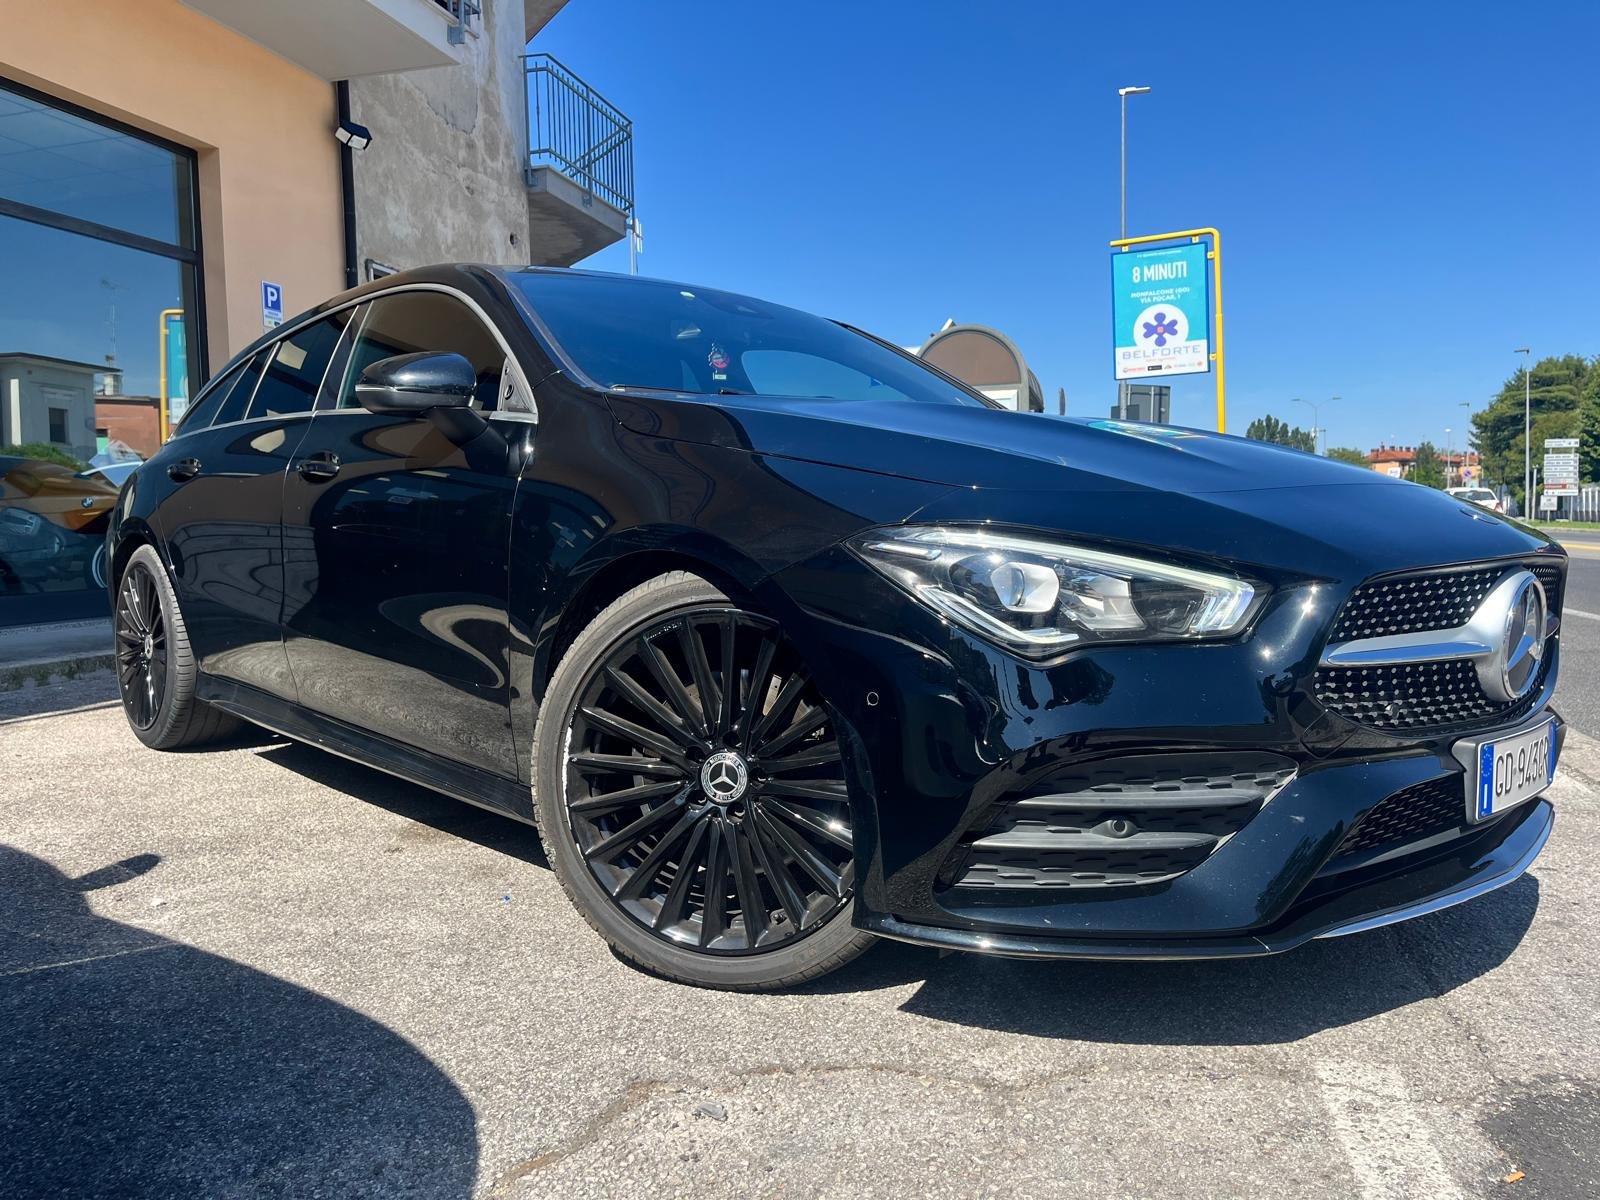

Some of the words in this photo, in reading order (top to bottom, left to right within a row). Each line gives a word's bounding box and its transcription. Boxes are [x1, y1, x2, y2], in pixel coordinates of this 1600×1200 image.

[1132, 265, 1141, 283] 8
[1143, 260, 1188, 282] MINUTI
[266, 286, 278, 308] P
[1141, 296, 1153, 304] VIA
[1122, 343, 1202, 361] BELFORTE
